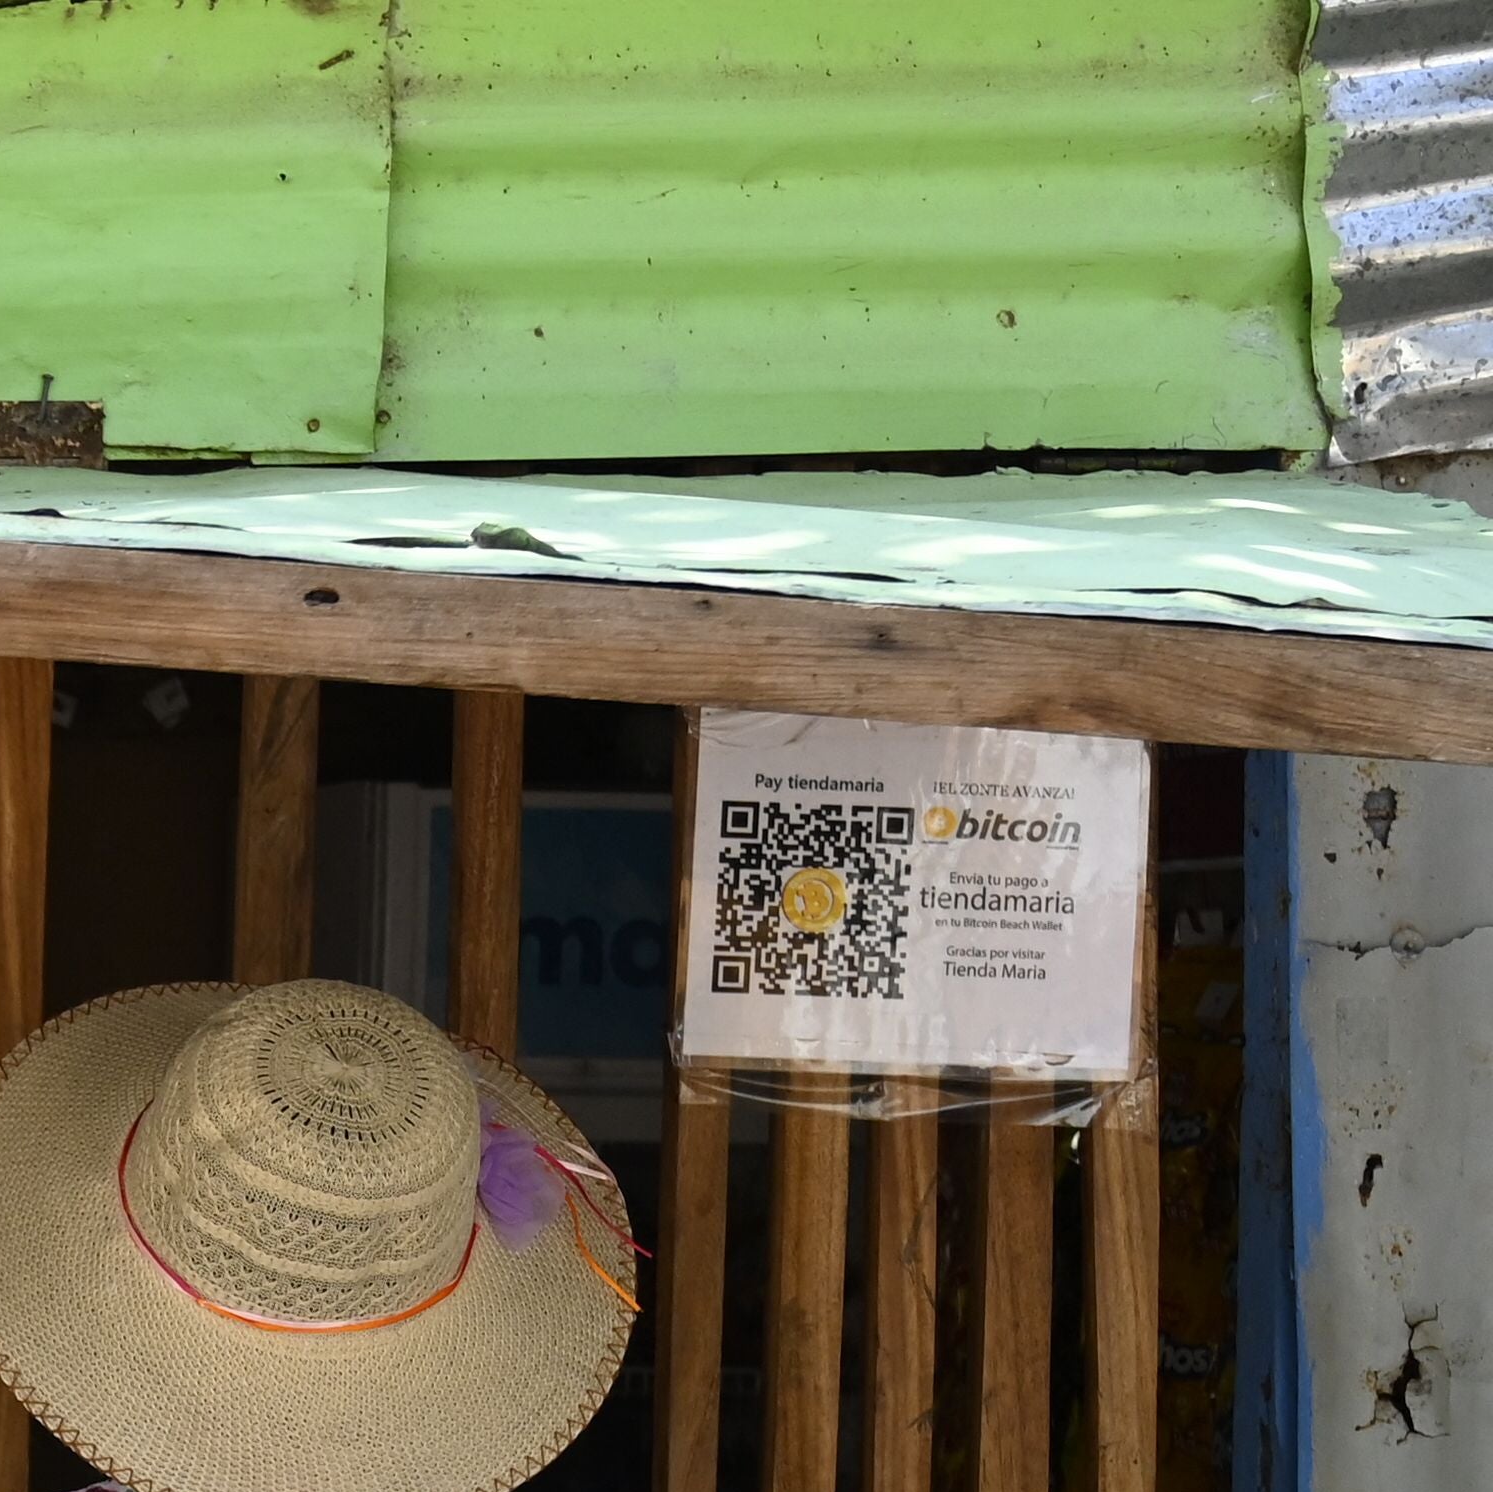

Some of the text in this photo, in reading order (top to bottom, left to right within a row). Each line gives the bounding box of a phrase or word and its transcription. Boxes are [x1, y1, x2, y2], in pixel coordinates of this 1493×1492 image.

[755, 773, 885, 793] Pay tiendamaria
[960, 782, 1010, 798] ZONTE
[1012, 784, 1075, 800] AVANZA!
[955, 808, 1081, 844] bitcoin
[988, 874, 1001, 886] tu
[1005, 875, 1038, 890] pago
[920, 886, 1075, 914] tiendamaria
[935, 917, 1063, 931] en tu Bitcoin Beach Wallet
[946, 945, 1046, 960] Gracias por visitar
[943, 961, 1046, 980] Tienda Maria
